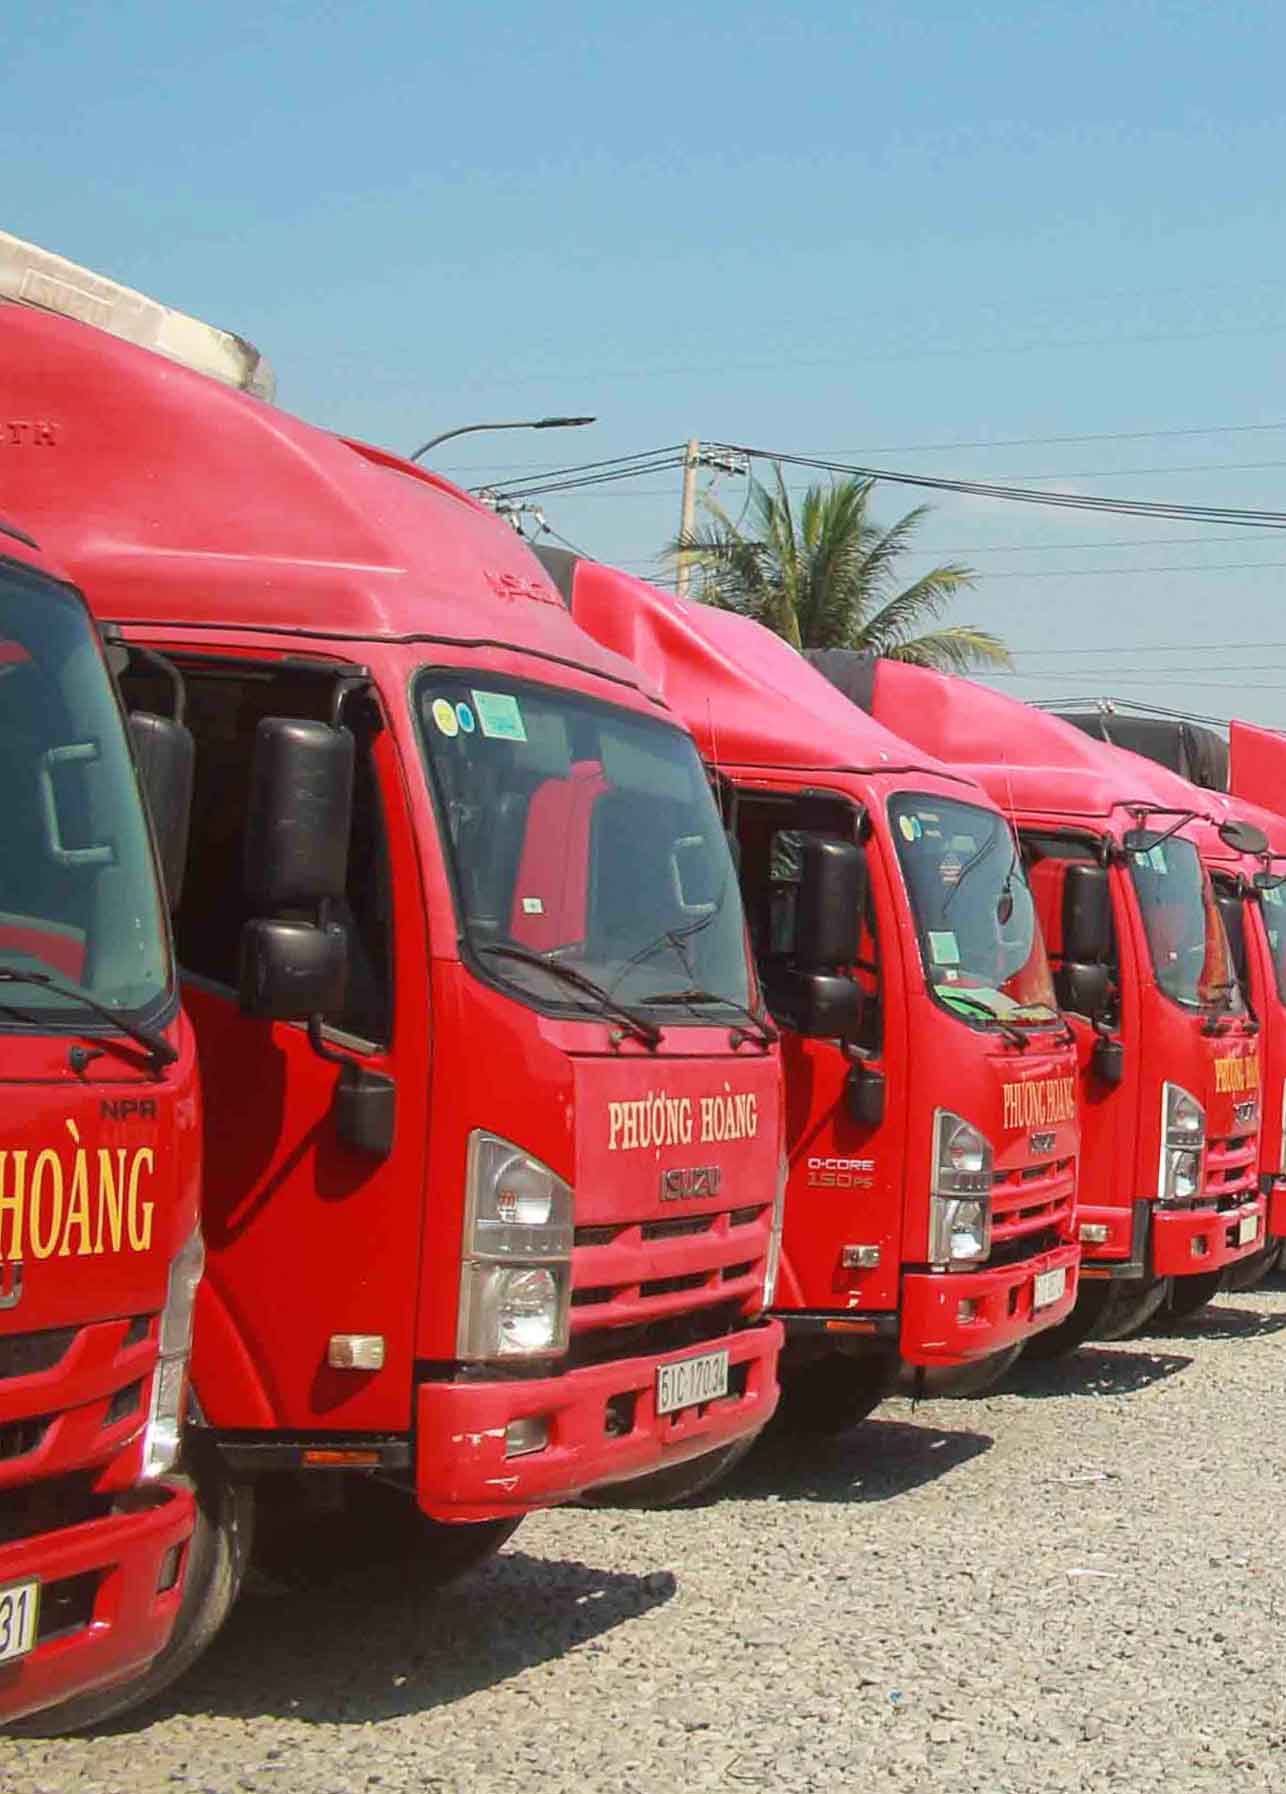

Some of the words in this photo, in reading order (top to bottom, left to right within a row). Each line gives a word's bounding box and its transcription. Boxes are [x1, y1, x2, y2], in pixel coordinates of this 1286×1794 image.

[101, 1100, 157, 1119] NPR
[608, 1088, 693, 1160] PHƯỢNG
[700, 1080, 758, 1143] HOÀNG
[808, 1158, 875, 1171] D-CORE
[0, 1118, 155, 1260] HOÀNG
[660, 1166, 721, 1200] ISUZU
